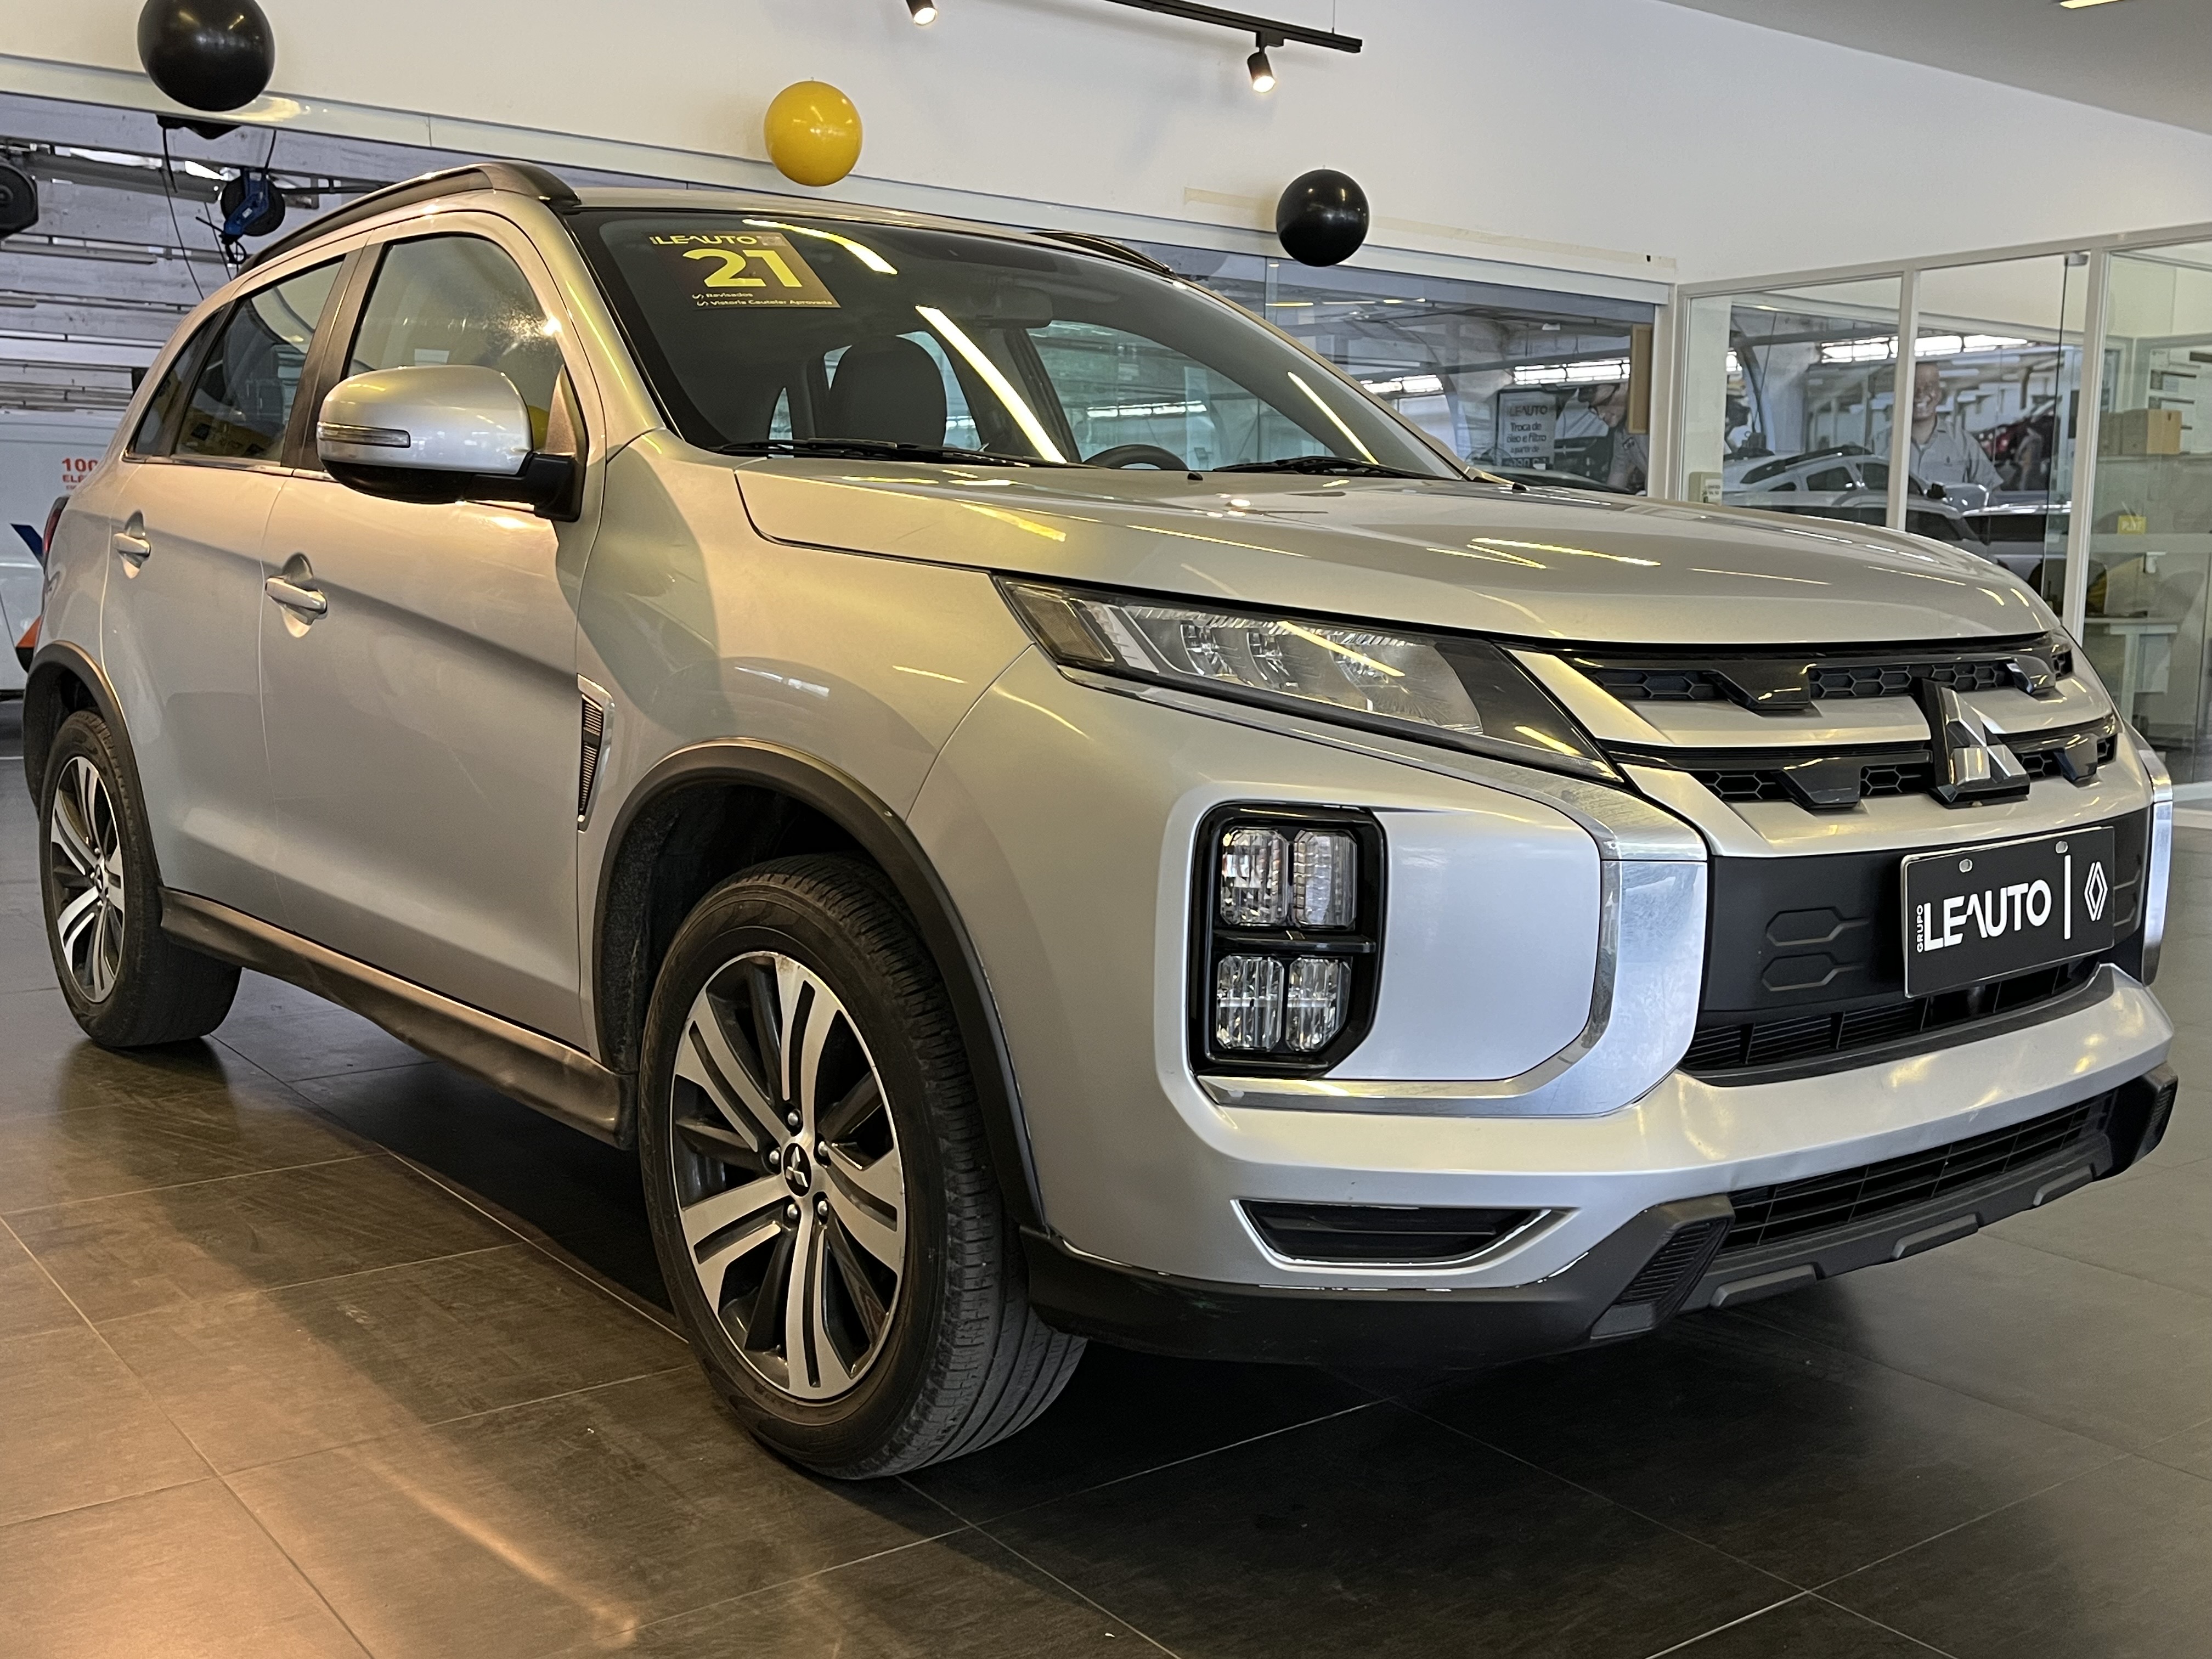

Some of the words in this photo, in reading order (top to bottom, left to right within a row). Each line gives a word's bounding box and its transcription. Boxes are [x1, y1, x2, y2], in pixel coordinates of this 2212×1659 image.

[655, 235, 757, 245] LEAUTO
[682, 249, 802, 287] 21
[1510, 421, 1531, 432] Troca
[1532, 421, 1542, 431] de
[1528, 432, 1546, 443] filtro
[1924, 879, 2052, 952] LEAUTO
